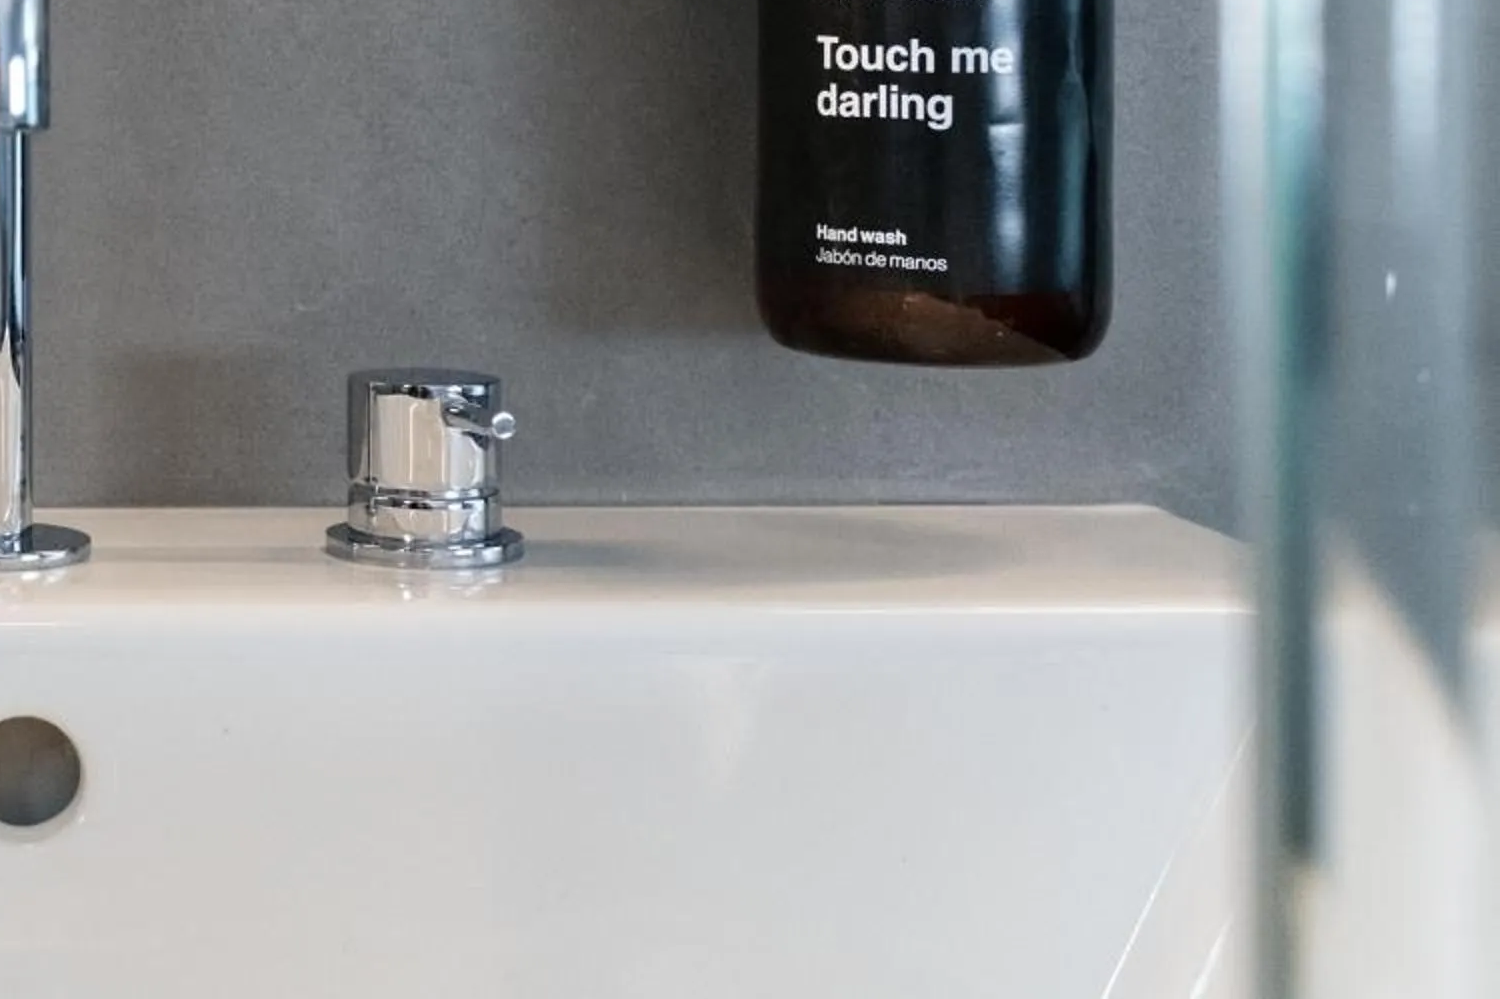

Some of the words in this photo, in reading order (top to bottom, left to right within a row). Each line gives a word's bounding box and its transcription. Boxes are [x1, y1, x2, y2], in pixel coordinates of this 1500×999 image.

[816, 35, 936, 74] Touch
[950, 44, 1015, 74] me
[816, 82, 954, 131] darling
[816, 223, 858, 244] Hand
[860, 227, 908, 246] wash
[816, 246, 863, 268] Jabón
[864, 250, 888, 268] de
[889, 253, 949, 273] manos
